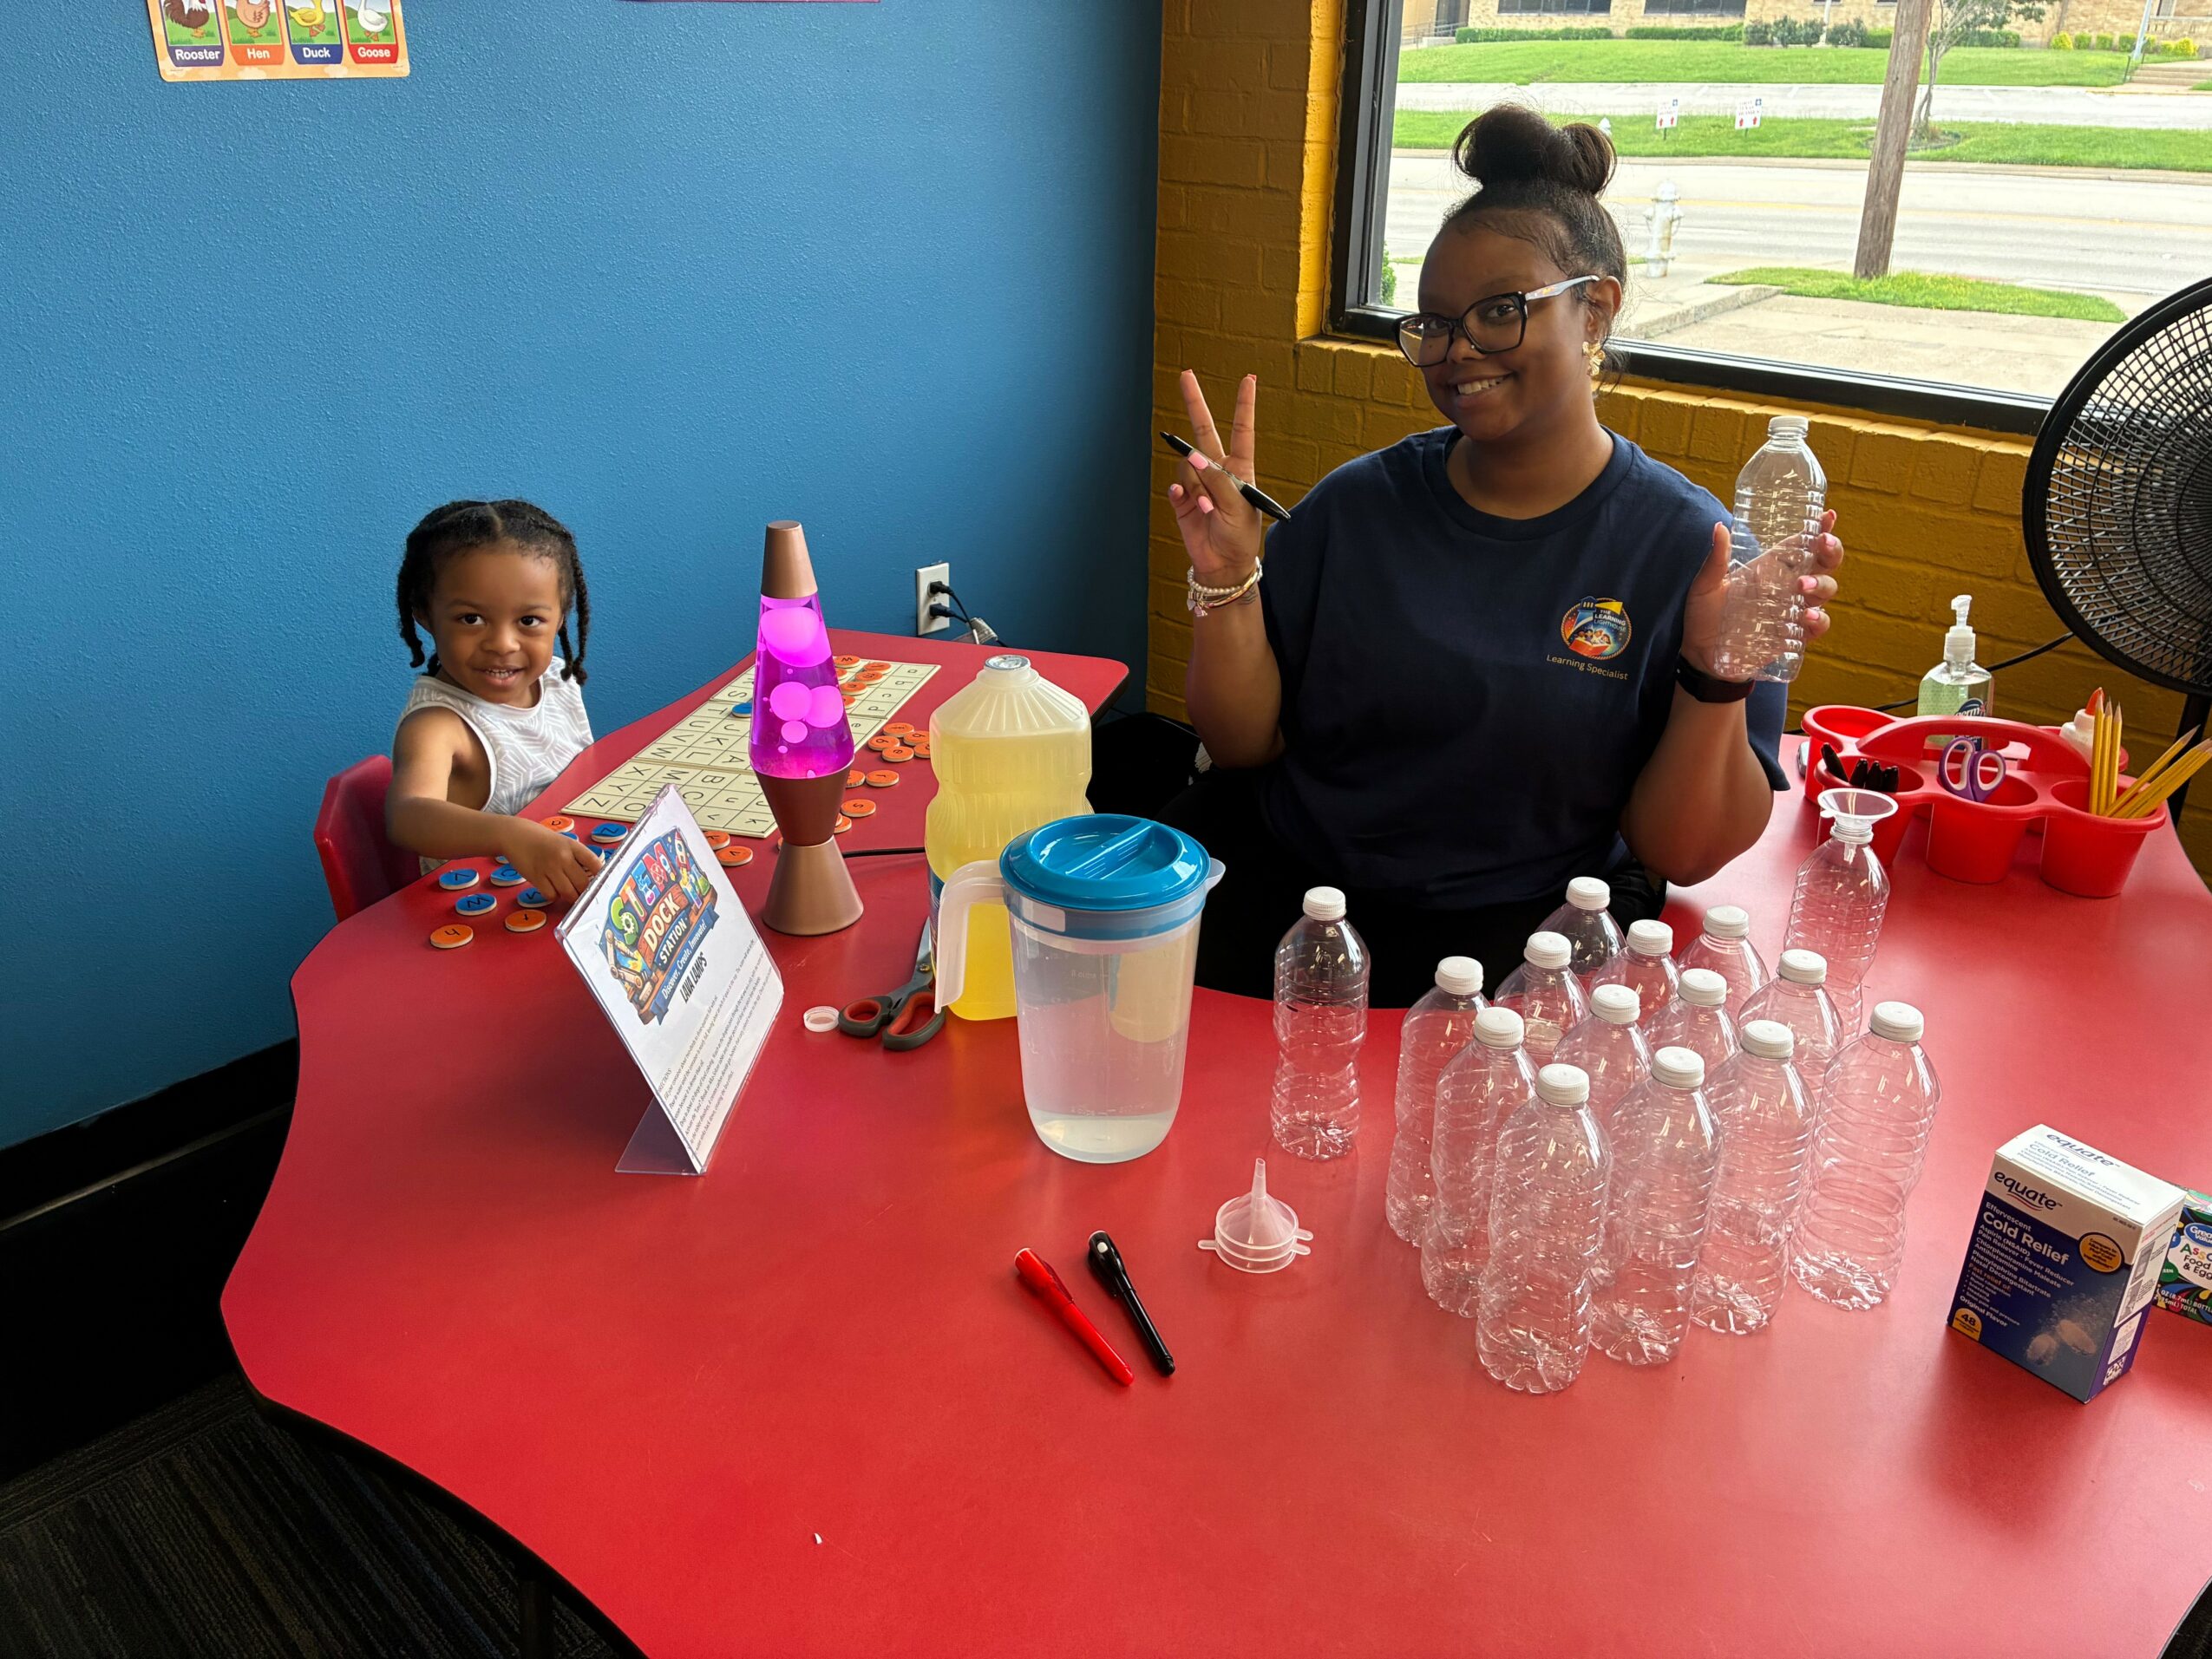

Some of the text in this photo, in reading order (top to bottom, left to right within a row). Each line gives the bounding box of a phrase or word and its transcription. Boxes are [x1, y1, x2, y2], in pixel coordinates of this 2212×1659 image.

[175, 47, 391, 60] Rooster Hen Duck Goose
[1594, 619, 1626, 631] LIGHTHOUSE
[1595, 614, 1626, 626] LEARNING
[1547, 654, 1629, 681] Learning Specialist
[704, 737, 729, 746] K
[625, 767, 651, 776] X
[722, 755, 744, 765] A
[608, 783, 632, 792] Y
[701, 774, 725, 784] B
[624, 802, 646, 812] O
[682, 792, 704, 800] C
[611, 841, 677, 945] STEM
[644, 892, 680, 952] DOCK
[659, 918, 688, 964] STATION
[661, 919, 708, 1000] Discover, Create, Innovate!
[679, 951, 708, 1003] LAVA LAMPS
[2030, 1144, 2057, 1159] Cold
[2058, 1158, 2096, 1177] Relief
[2046, 1133, 2115, 1166] equate
[1994, 1171, 2058, 1211] equate
[1986, 1201, 2032, 1231] Effervescent
[1980, 1224, 2031, 1257] Aspirin (NSAID)
[1983, 1212, 2019, 1239] Cold
[2021, 1232, 2070, 1265] Relief
[1974, 1243, 2019, 1272] Antihistamine
[1976, 1237, 2061, 1289] Chlorpheniramine Maleate
[1978, 1230, 1993, 1242] Pain
[1993, 1238, 2019, 1257] Reliever
[2024, 1257, 2044, 1270] Fever
[2045, 1267, 2075, 1286] Reducer
[2183, 1255, 2211, 1270] Food
[2183, 1263, 2190, 1271] &
[1971, 1256, 2035, 1297] Nasal Decongestant
[1973, 1250, 2052, 1298] Phenylephrine Bitartrate
[1960, 1296, 1986, 1315] Original
[1986, 1311, 2008, 1327] Flavor
[1961, 1314, 1976, 1326] 48
[2180, 1303, 2197, 1315] TOTAL
